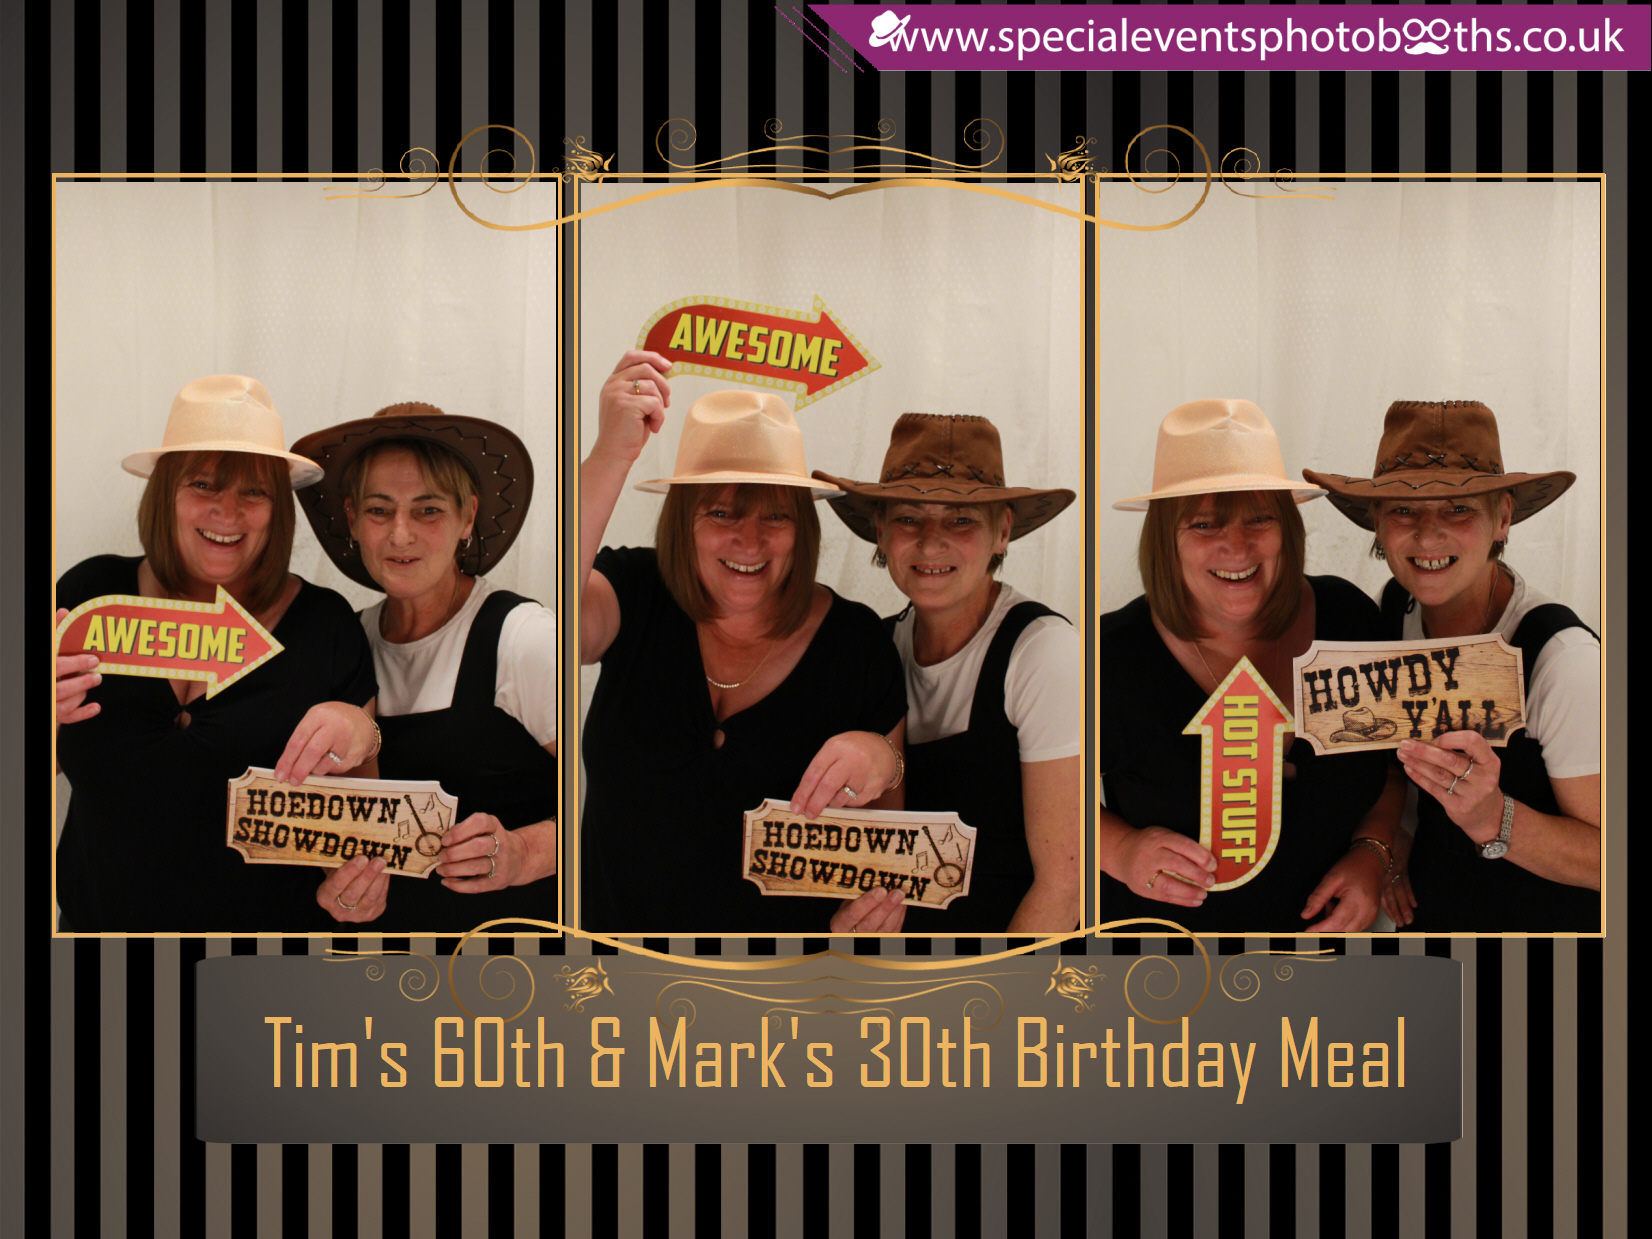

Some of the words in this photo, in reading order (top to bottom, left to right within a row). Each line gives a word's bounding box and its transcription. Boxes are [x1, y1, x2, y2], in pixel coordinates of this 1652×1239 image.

[669, 313, 843, 377] AWESOME
[83, 615, 247, 664] AWESOME
[1303, 647, 1460, 714] HOWDY
[1222, 695, 1259, 761] HOT
[247, 789, 401, 824] HOEDOWN
[1221, 768, 1258, 865] STUFF
[233, 817, 412, 870] SHOWDOWN
[763, 821, 919, 856] HOEDOWN
[750, 849, 931, 901] SHOWDOWN
